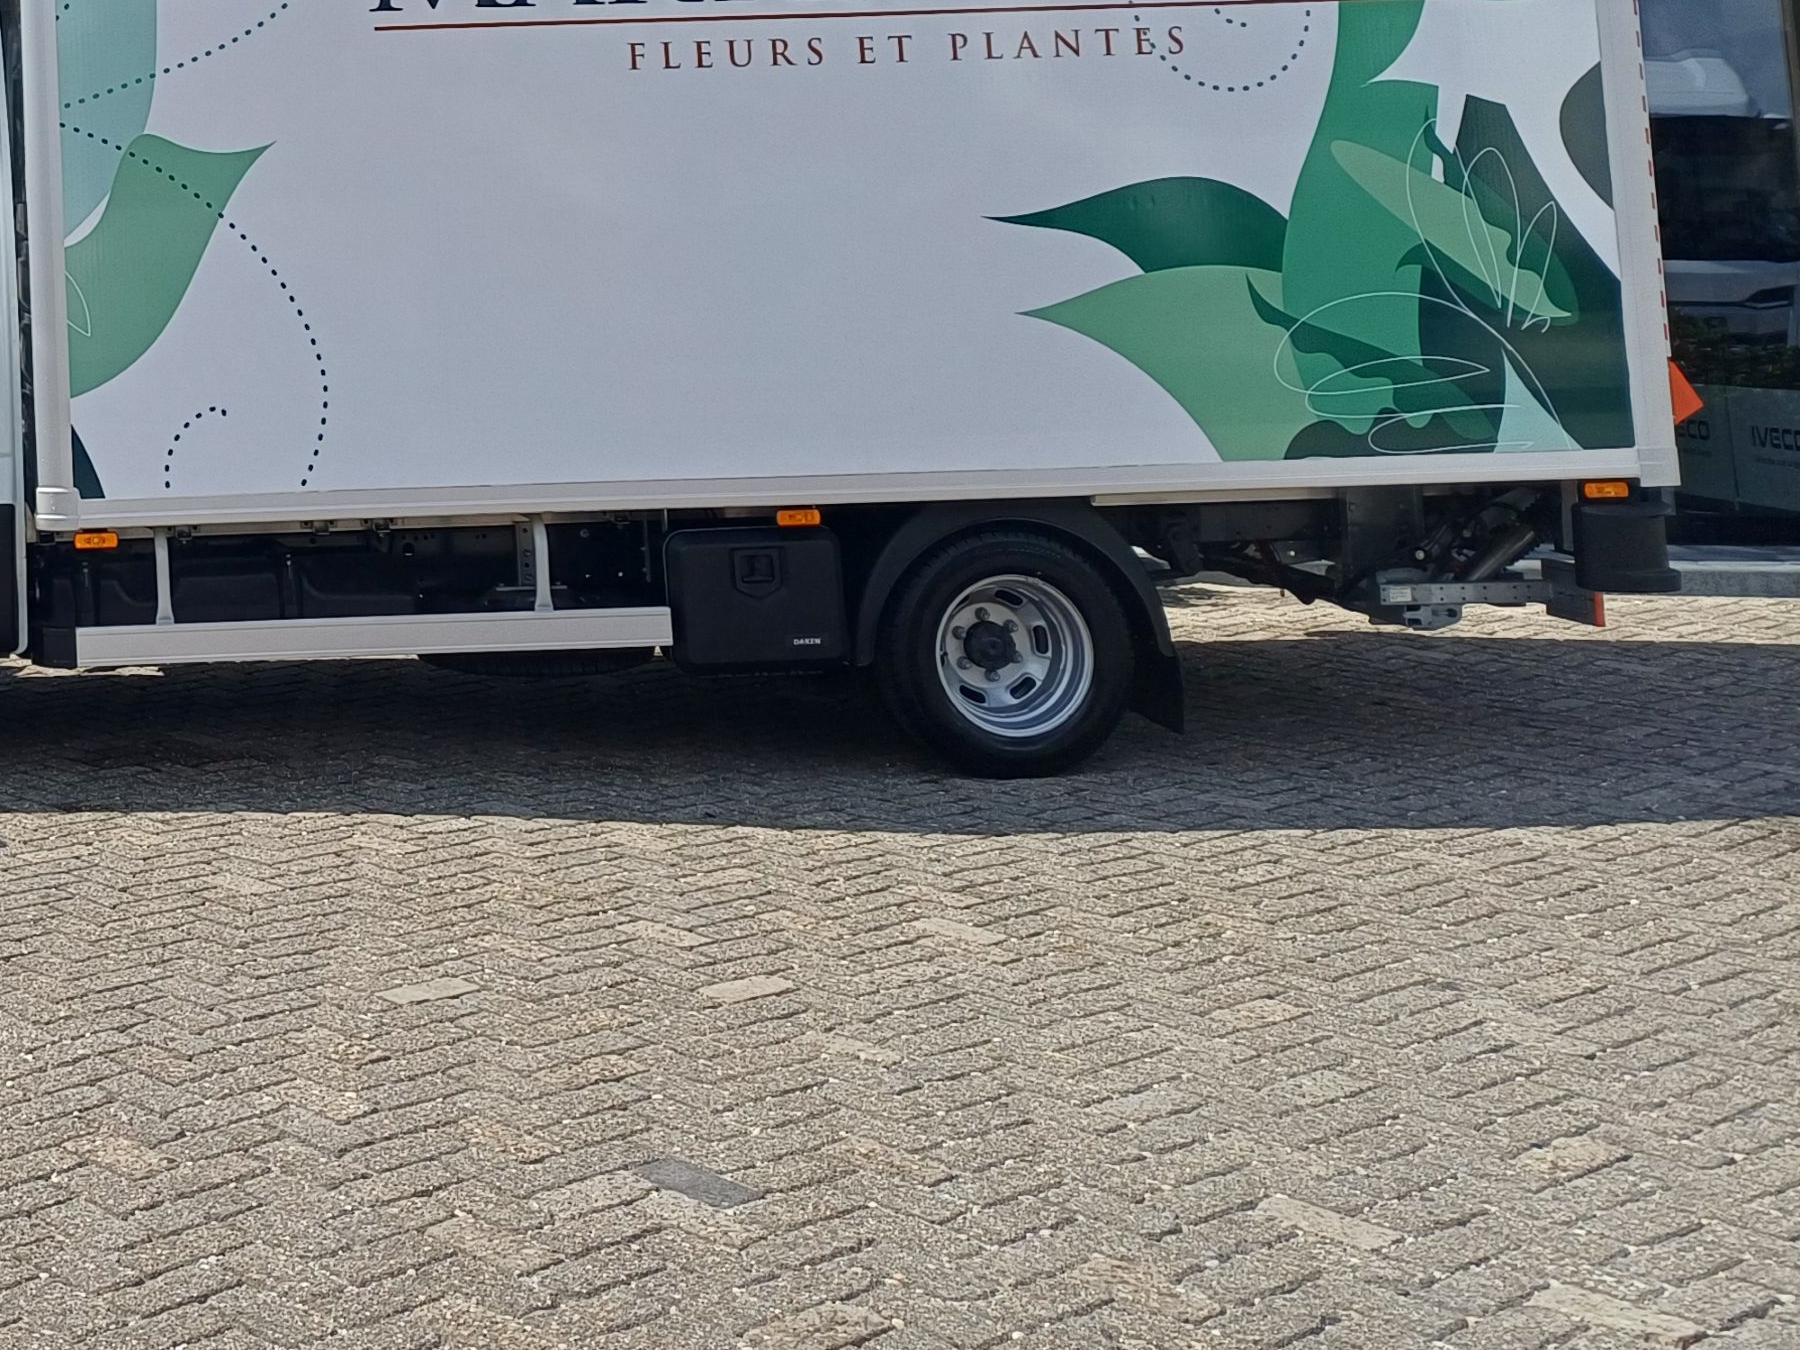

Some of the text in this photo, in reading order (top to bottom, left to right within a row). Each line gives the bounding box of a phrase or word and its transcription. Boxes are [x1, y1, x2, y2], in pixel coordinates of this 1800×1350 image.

[628, 25, 1187, 71] FLEURS ET PLANTES
